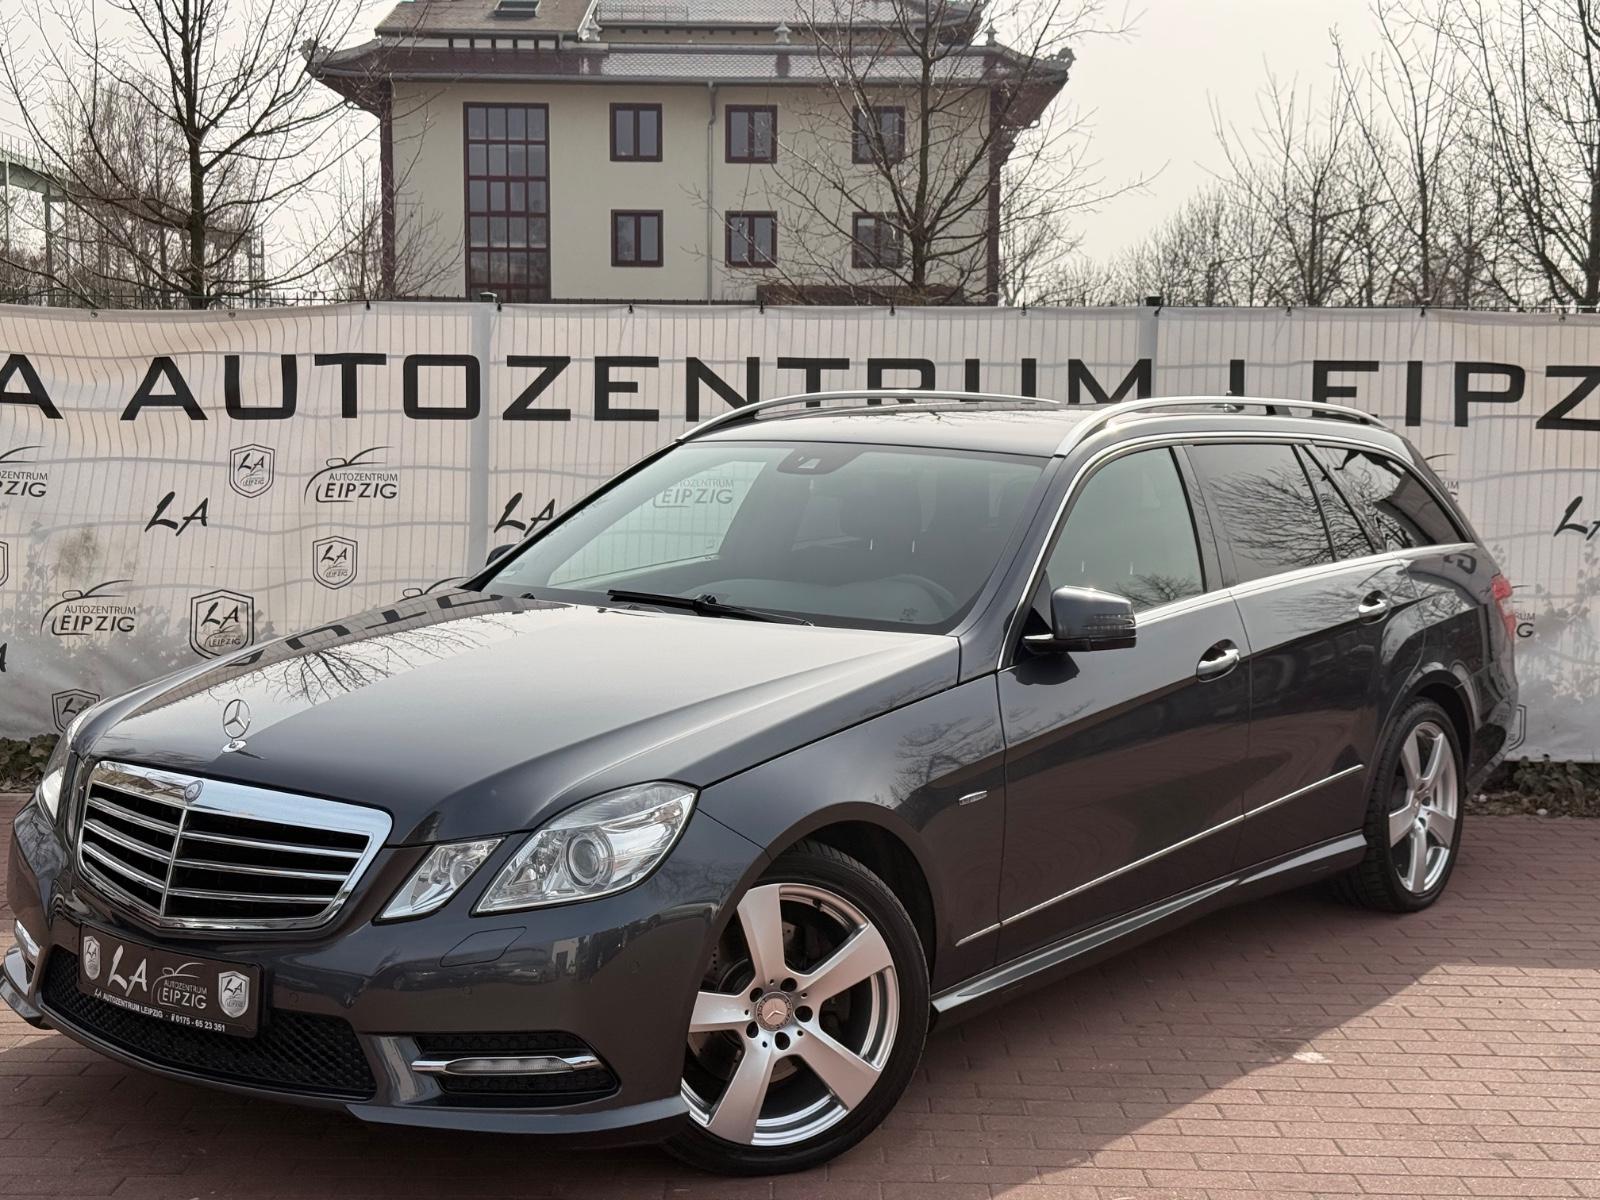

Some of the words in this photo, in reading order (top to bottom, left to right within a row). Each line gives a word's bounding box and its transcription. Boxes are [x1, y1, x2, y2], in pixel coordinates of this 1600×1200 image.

[237, 453, 264, 472] LA
[329, 472, 398, 481] AUTOZENTRUM
[145, 491, 208, 536] LA
[494, 492, 555, 537] LA
[320, 545, 347, 564] LA
[64, 604, 136, 615] AUTOZENTRUM
[201, 602, 239, 629] LA
[107, 945, 147, 997] LA
[163, 979, 208, 995] AUTOZENTRUM
[223, 978, 243, 996] LA
[204, 1020, 213, 1030] 23
[213, 1023, 225, 1032] 351
